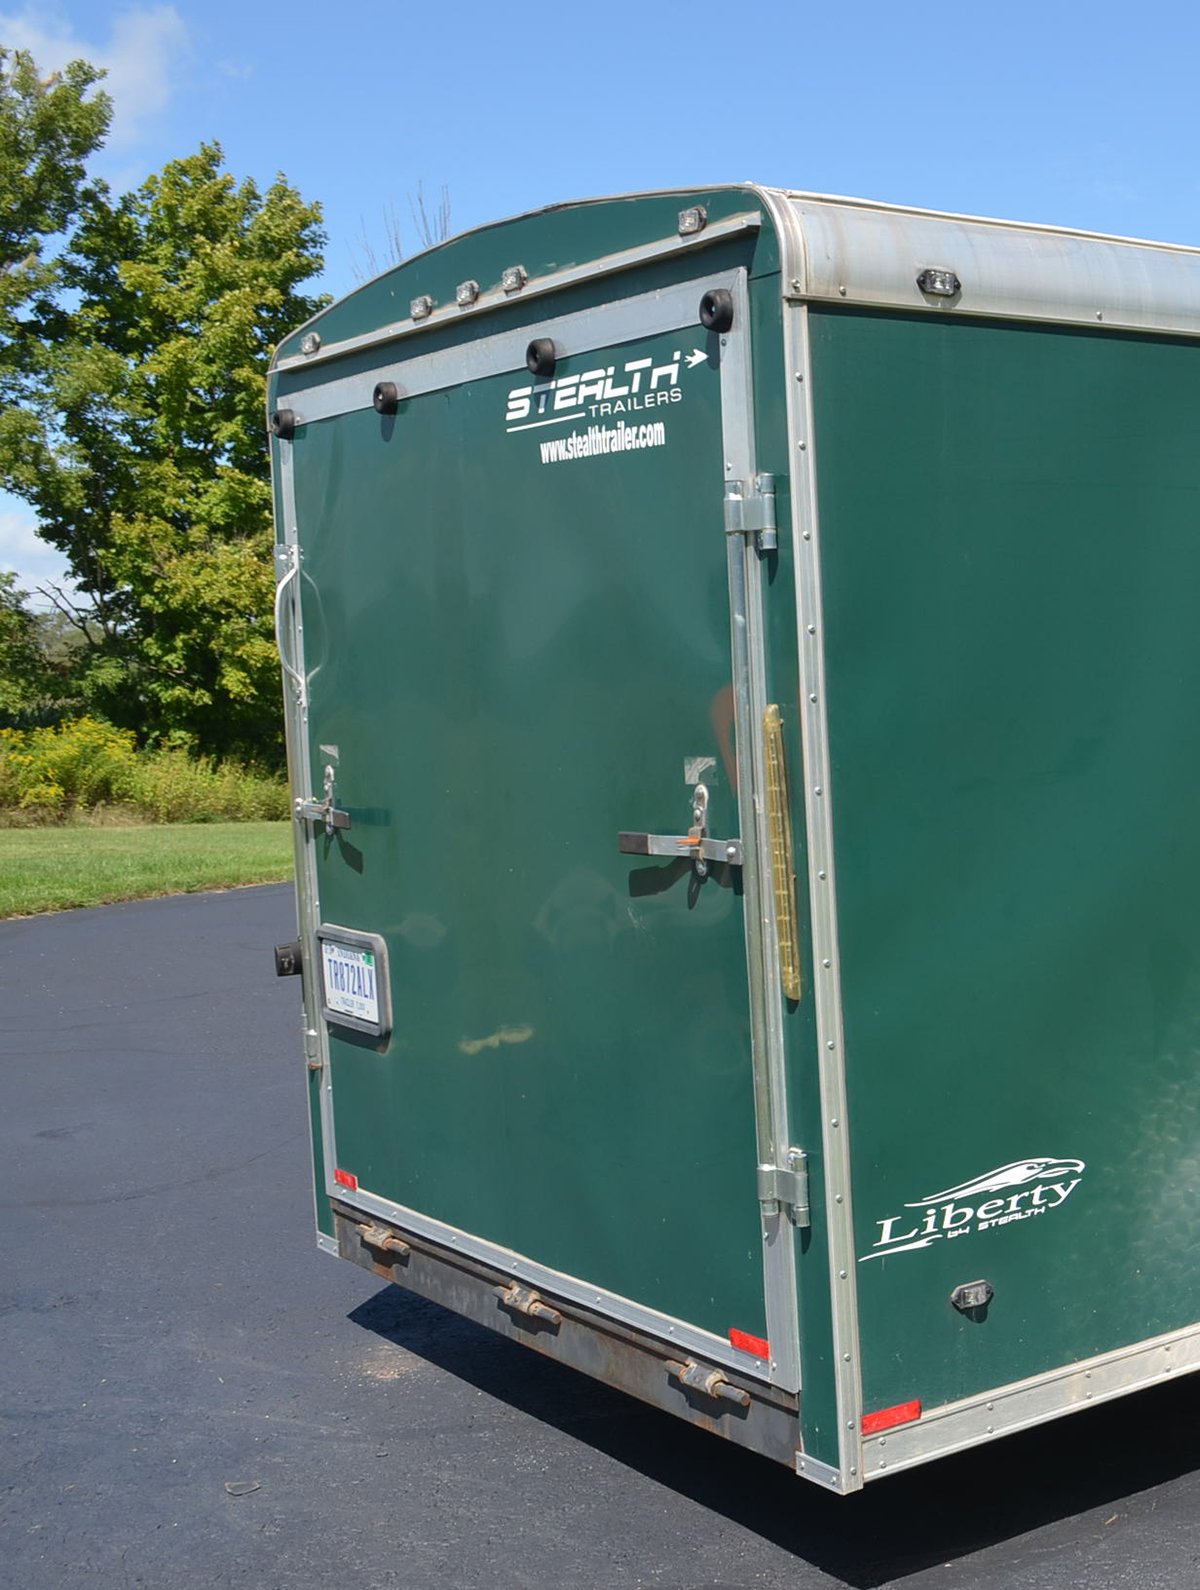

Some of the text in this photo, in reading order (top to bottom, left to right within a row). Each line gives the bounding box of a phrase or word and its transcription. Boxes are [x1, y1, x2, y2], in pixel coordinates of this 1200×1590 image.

[506, 351, 681, 421] STEALTH
[588, 387, 683, 418] TRAILERS
[540, 421, 666, 464] www.stealthtrailer.com
[327, 958, 375, 1000] TR872ALX
[872, 1178, 1083, 1247] Liberty
[947, 1205, 1046, 1239] by STEALTH
